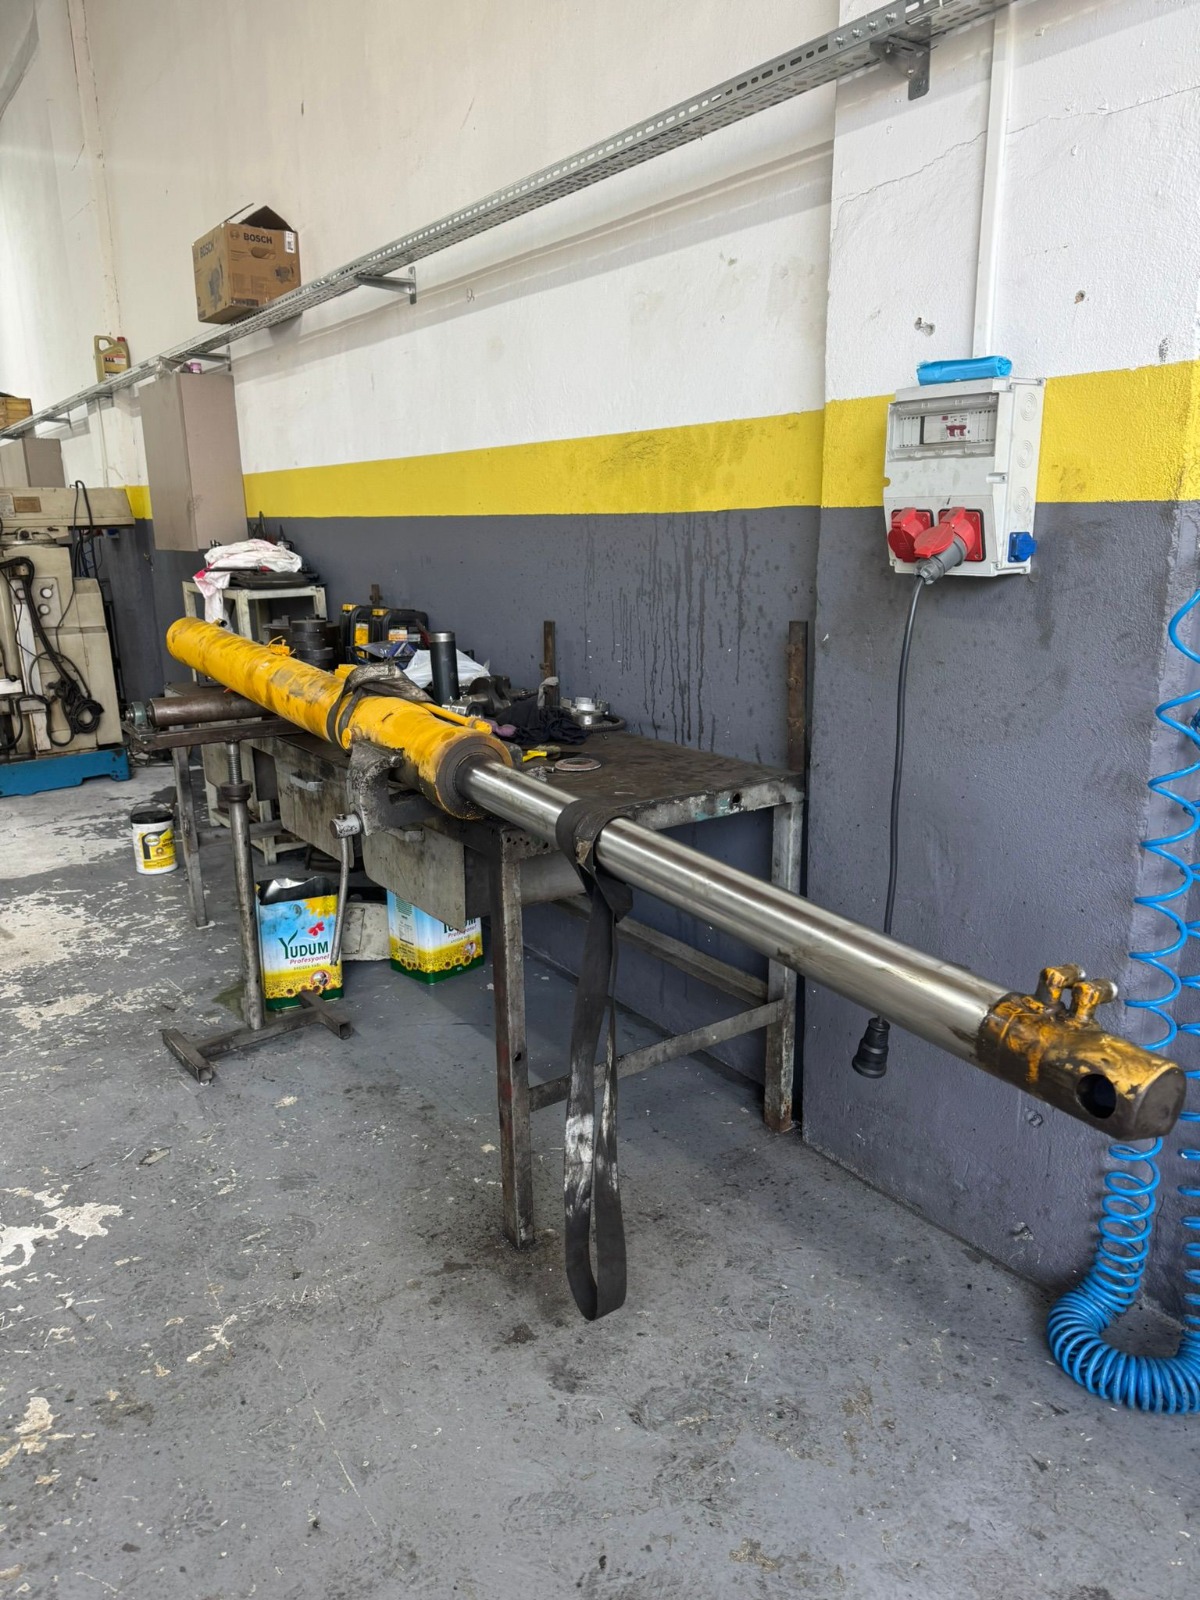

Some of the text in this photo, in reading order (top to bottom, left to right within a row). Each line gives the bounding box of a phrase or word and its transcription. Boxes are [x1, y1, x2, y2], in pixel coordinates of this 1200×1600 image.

[243, 232, 273, 244] BOSCH
[200, 241, 213, 257] BOSCH
[278, 929, 329, 960] YUDUM
[289, 953, 330, 965] Profesyonel
